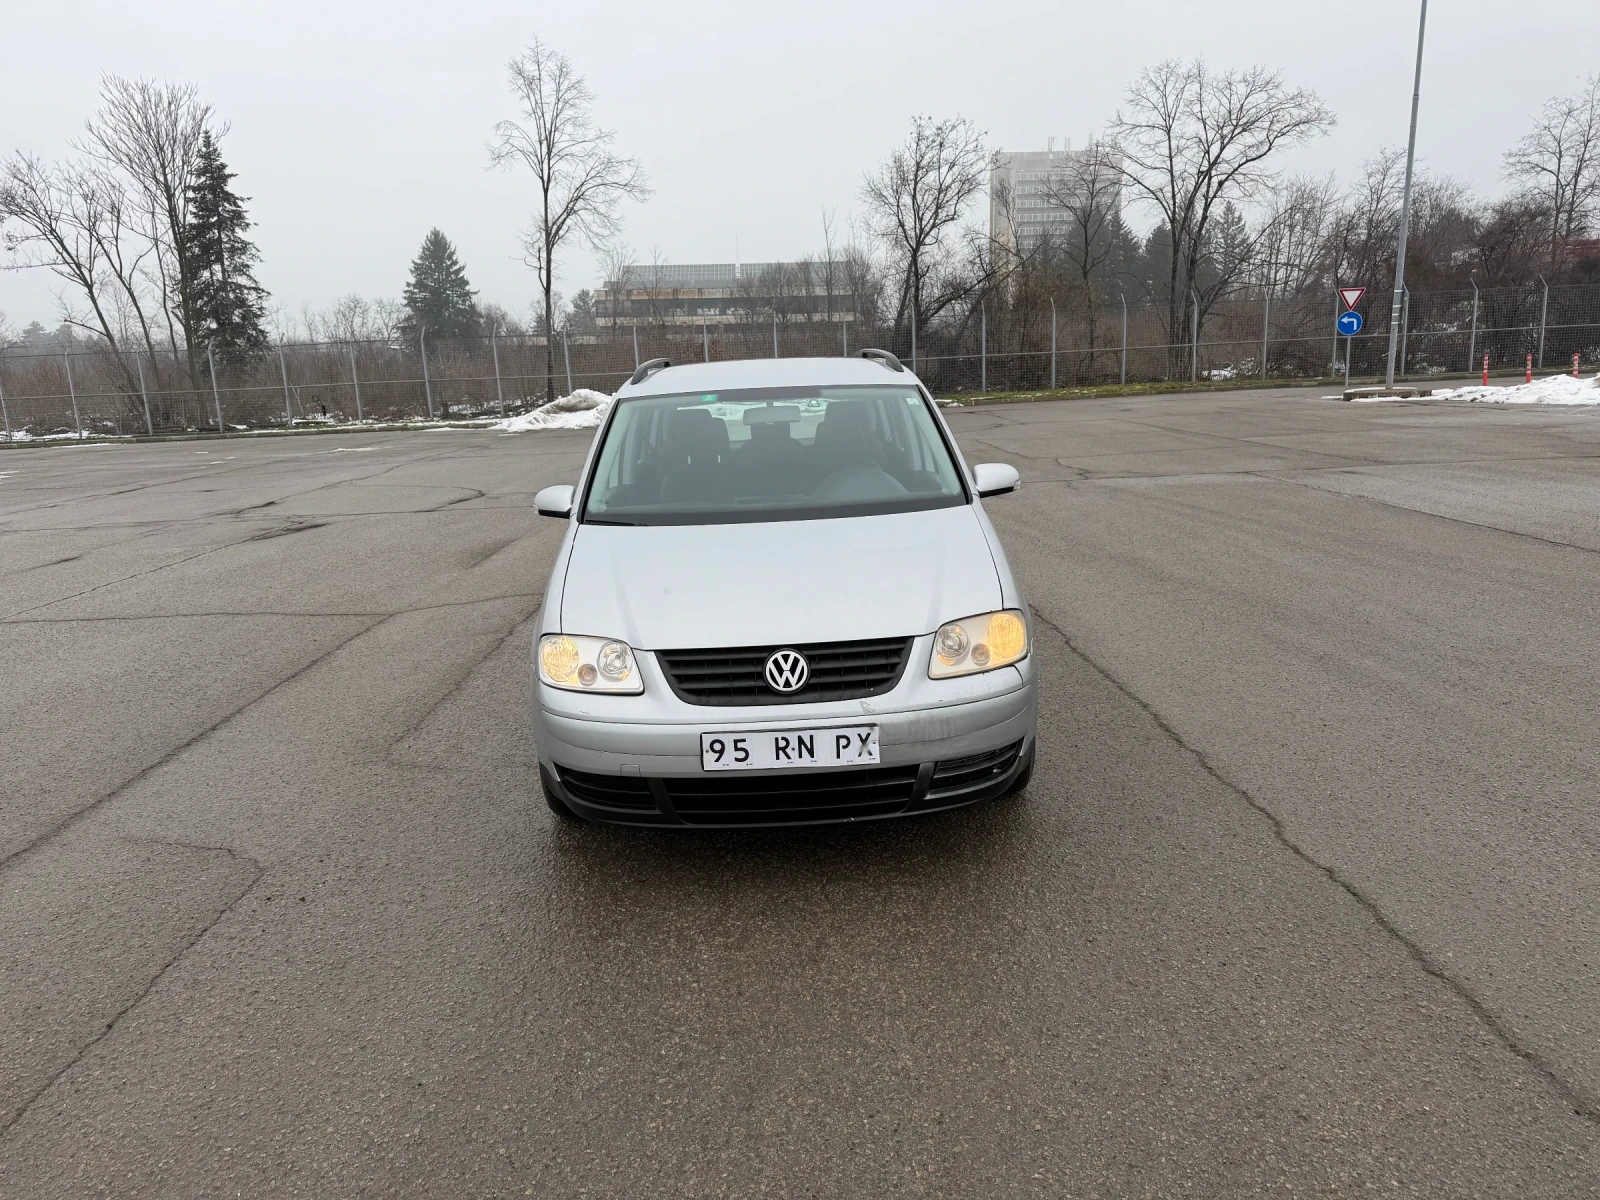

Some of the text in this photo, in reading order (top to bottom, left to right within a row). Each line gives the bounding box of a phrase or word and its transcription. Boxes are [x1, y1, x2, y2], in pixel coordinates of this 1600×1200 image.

[766, 651, 808, 691] VW
[709, 732, 873, 763] 95 RN PX
